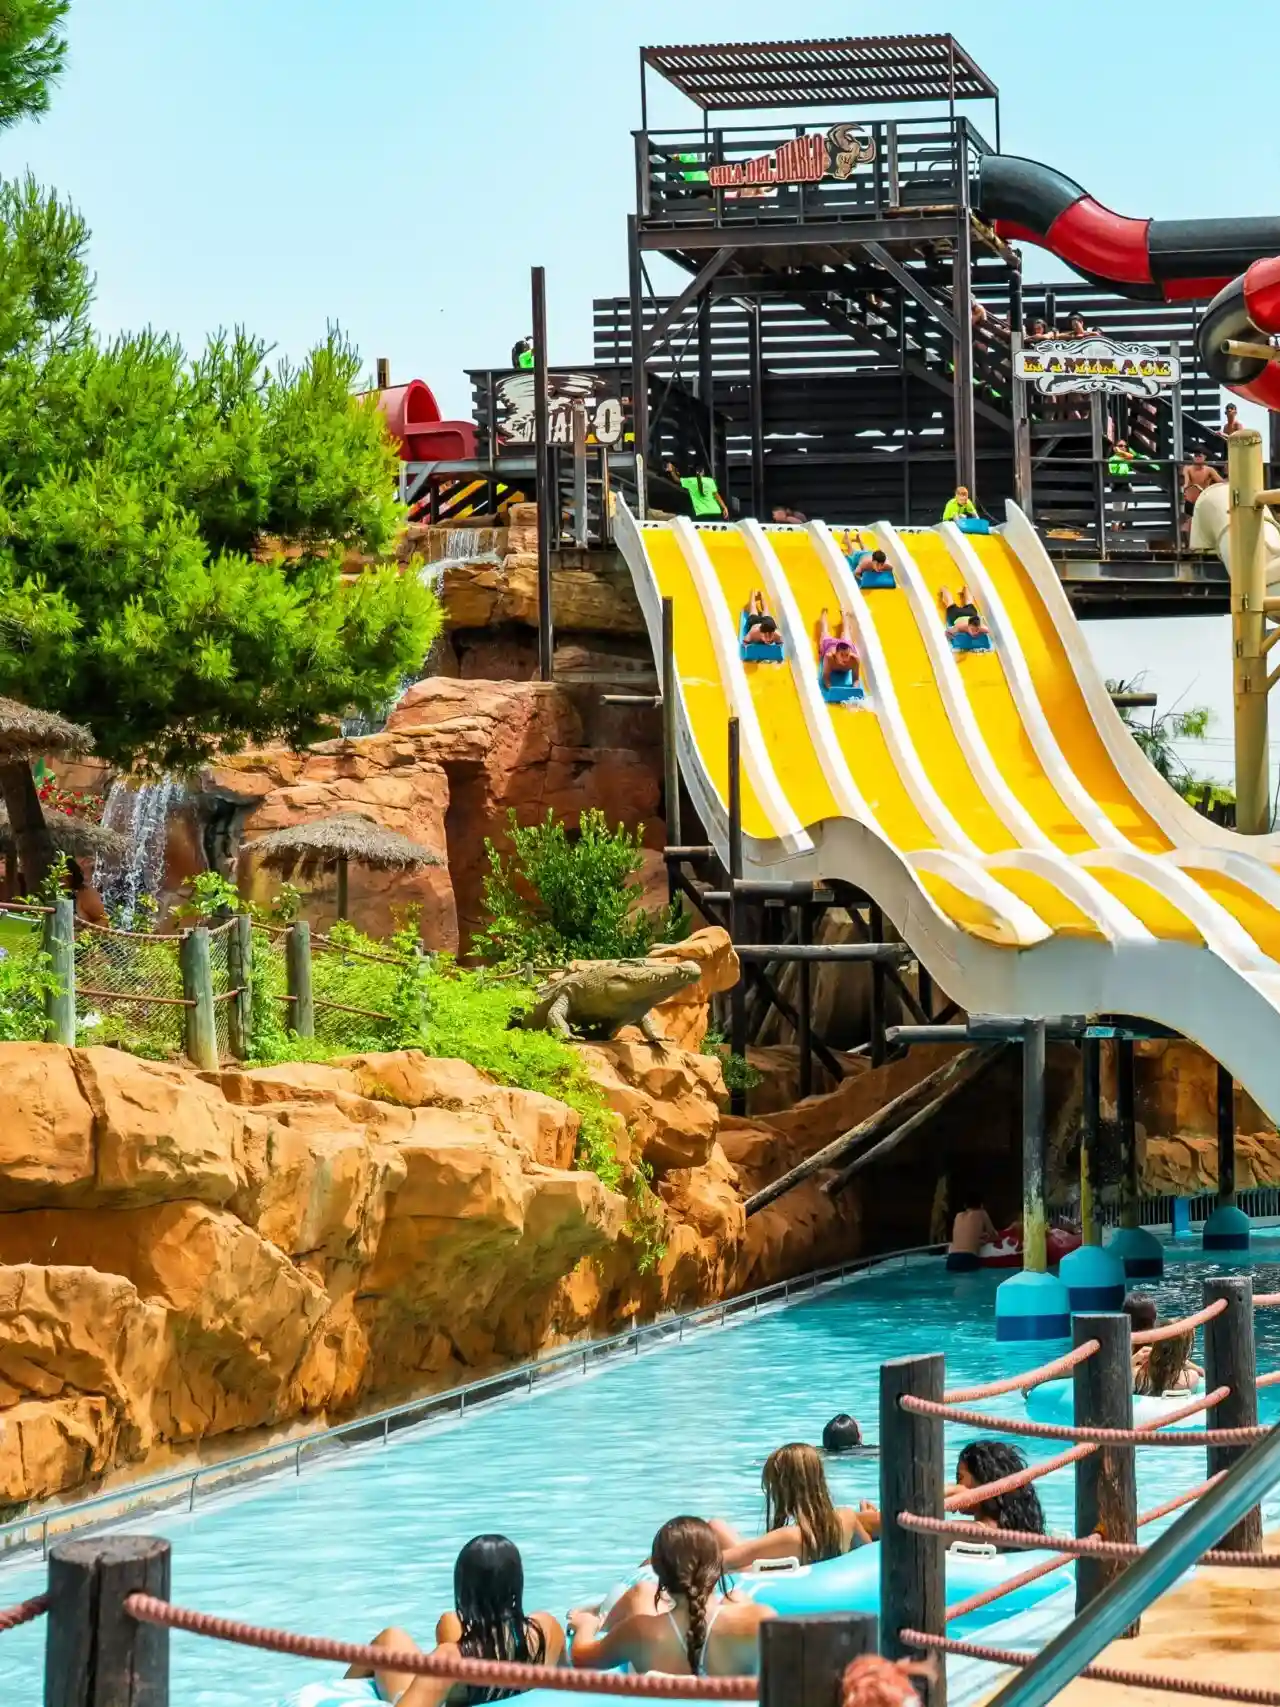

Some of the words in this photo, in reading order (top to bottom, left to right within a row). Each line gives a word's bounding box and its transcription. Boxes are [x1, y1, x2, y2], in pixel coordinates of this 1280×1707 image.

[709, 164, 744, 186] COLA
[745, 154, 774, 184] DEL
[775, 133, 824, 182] DIABLO
